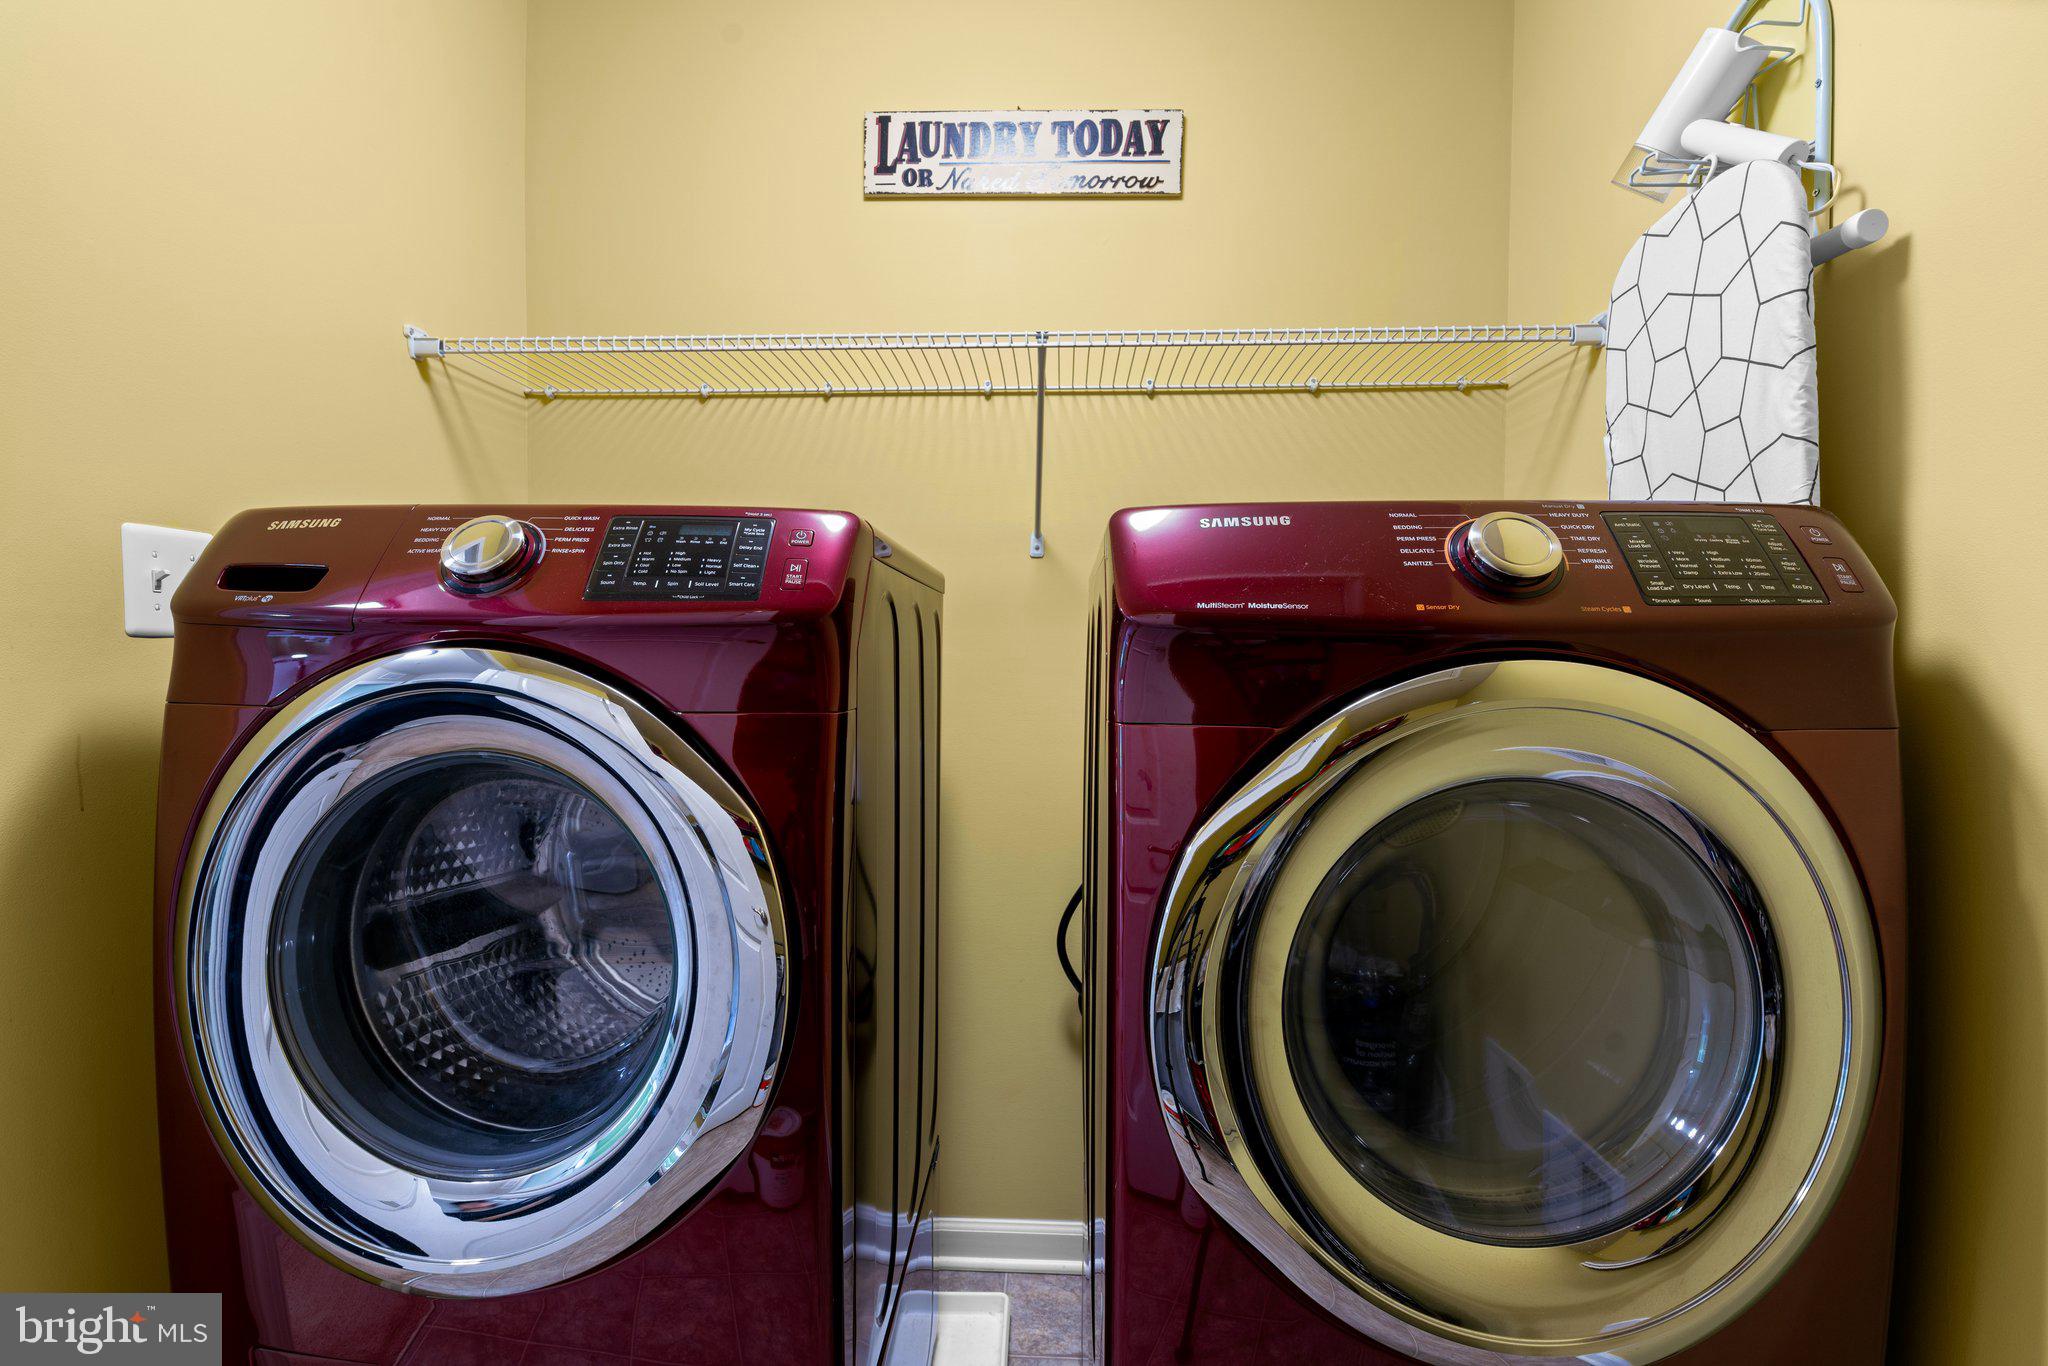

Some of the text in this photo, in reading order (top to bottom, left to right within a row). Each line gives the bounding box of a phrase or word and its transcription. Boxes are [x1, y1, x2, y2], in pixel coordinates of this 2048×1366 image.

[873, 115, 1171, 175] LAUNDRY TODAY
[901, 168, 934, 187] OR
[267, 518, 342, 530] SAMSUNG
[1200, 515, 1291, 528] SAMSUNG
